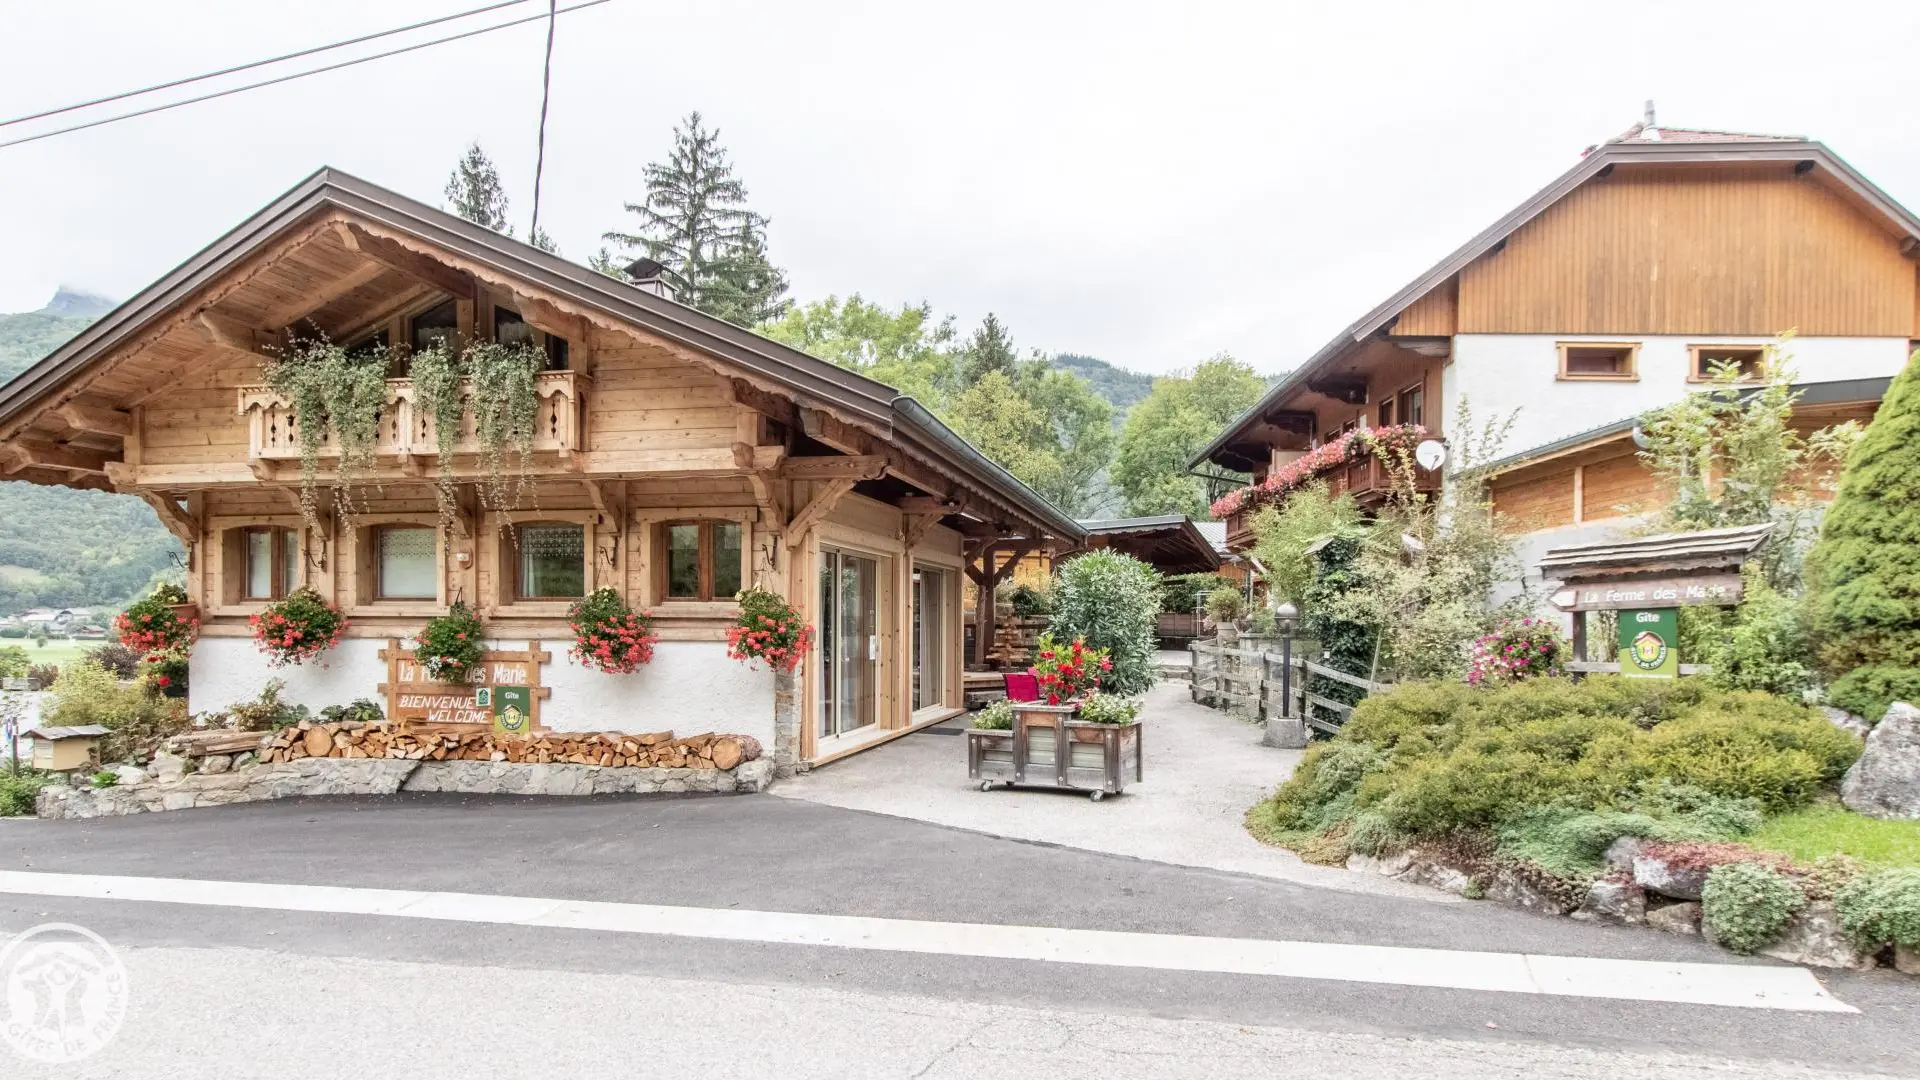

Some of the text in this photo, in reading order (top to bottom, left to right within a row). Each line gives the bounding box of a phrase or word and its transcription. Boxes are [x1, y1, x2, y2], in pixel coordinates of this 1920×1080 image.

[1584, 591, 1599, 602] La
[1606, 590, 1645, 601] Ferme
[1653, 587, 1677, 600] des
[400, 662, 414, 682] La
[493, 664, 527, 683] Marie
[400, 695, 476, 709] BIENVENUE
[428, 710, 490, 723] WELCOME
